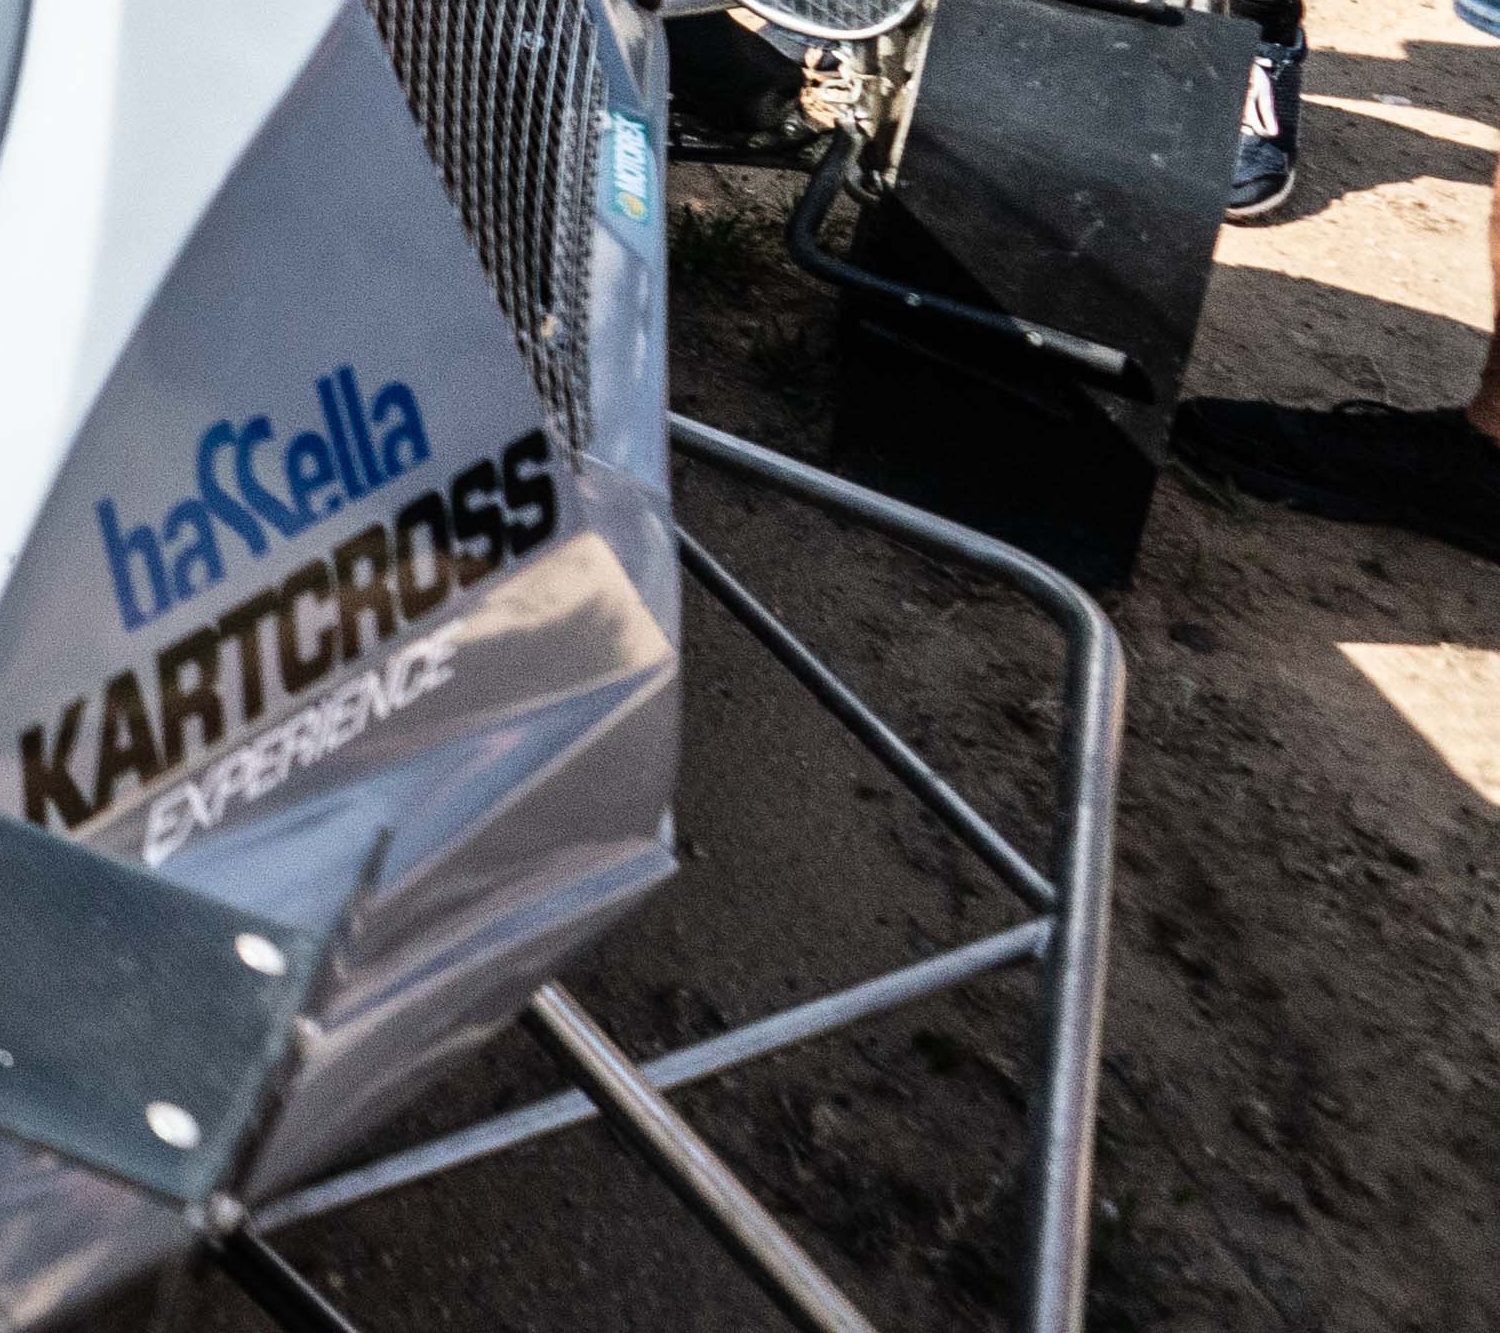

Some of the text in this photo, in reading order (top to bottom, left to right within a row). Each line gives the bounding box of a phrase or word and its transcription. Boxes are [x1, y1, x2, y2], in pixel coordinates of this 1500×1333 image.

[613, 111, 648, 199] MOTOREX
[15, 426, 561, 832] KARTCROSS
[143, 623, 465, 867] EXPERIENCE
